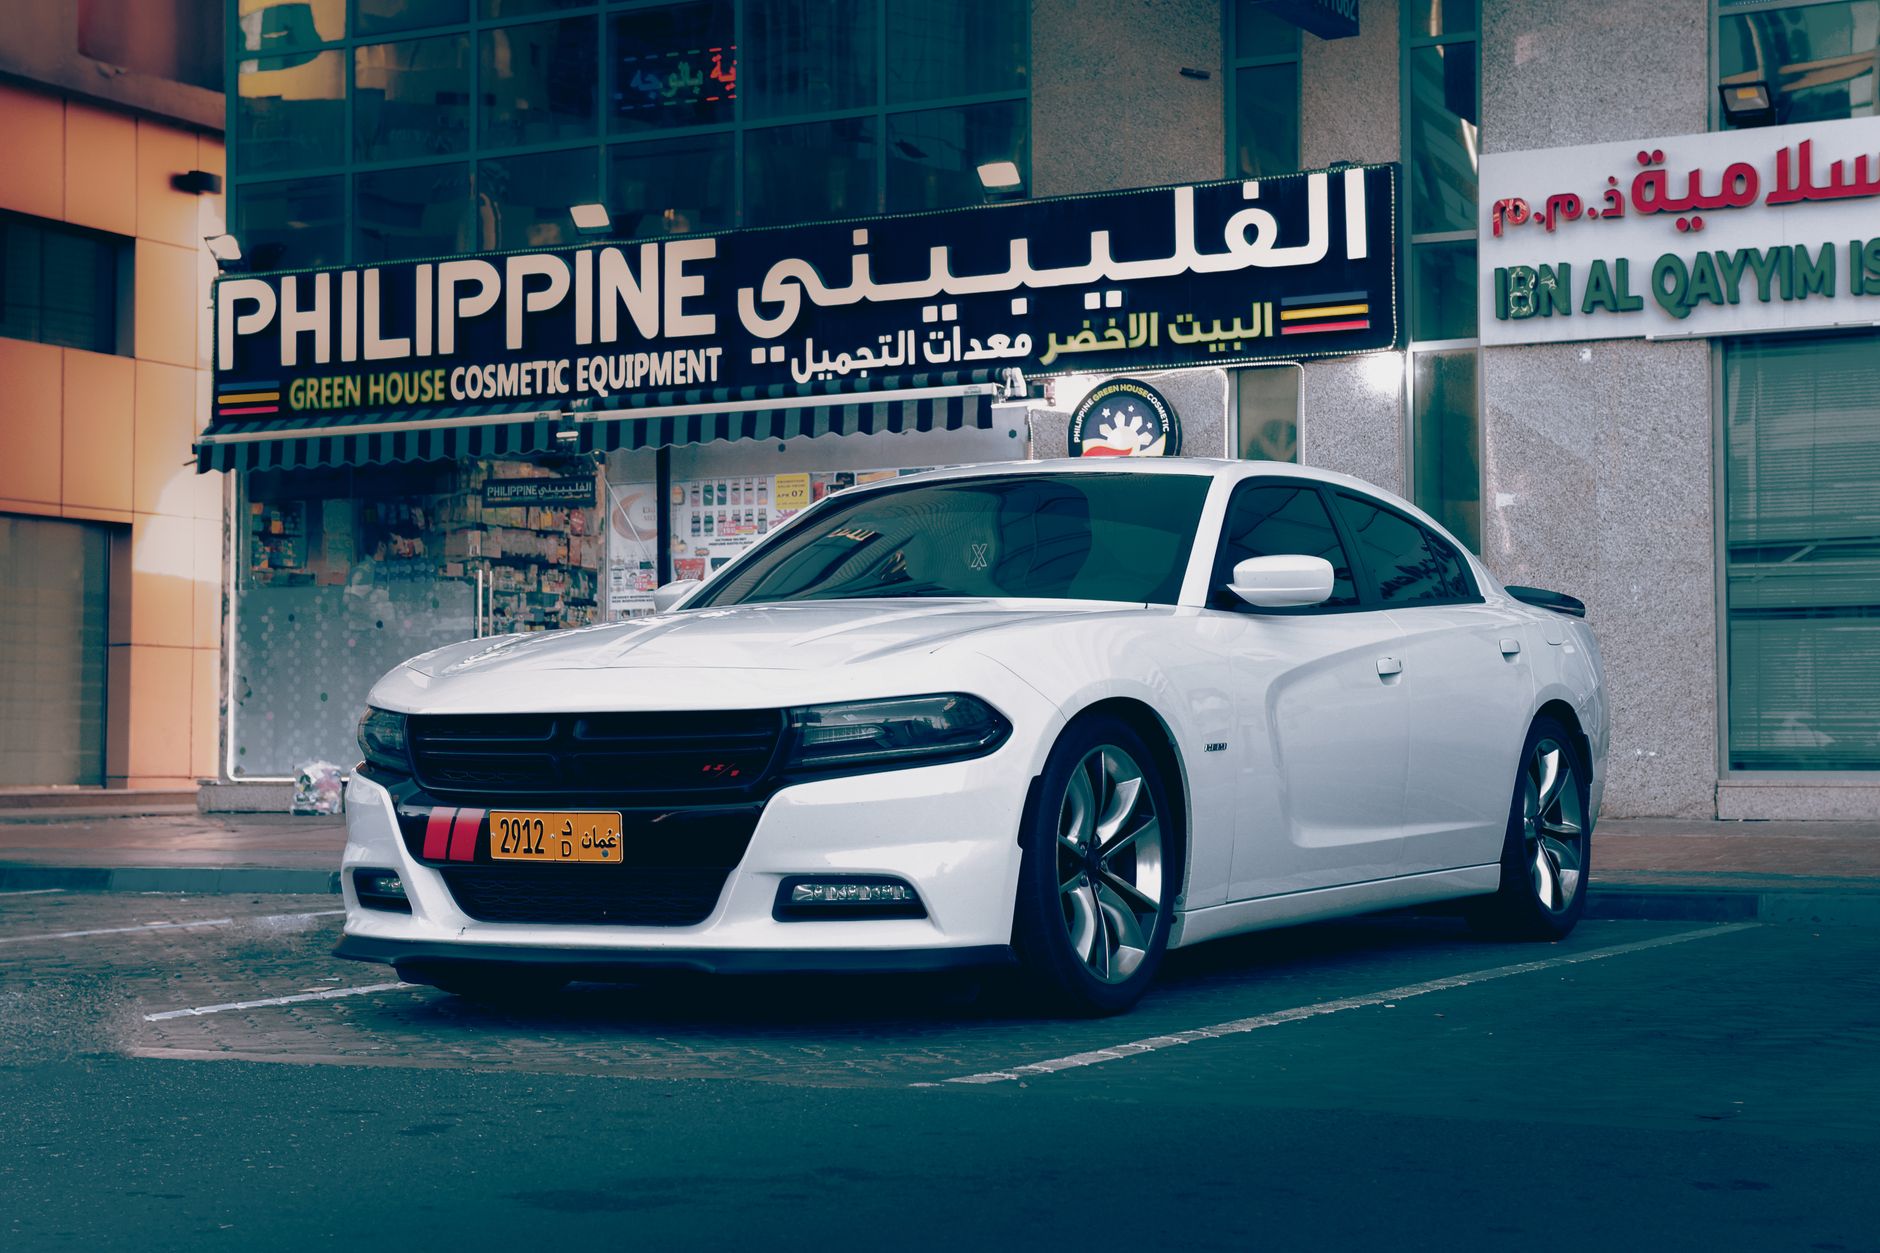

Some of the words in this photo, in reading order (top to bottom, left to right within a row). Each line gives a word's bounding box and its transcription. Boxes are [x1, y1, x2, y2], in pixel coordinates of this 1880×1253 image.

[737, 165, 1367, 364] الفليبيني
[1493, 262, 1573, 321] IBN
[1580, 257, 1645, 315] AL
[1651, 241, 1837, 320] QAYYIM
[219, 238, 717, 371] PHILIPPINE
[1167, 302, 1274, 349] البيت
[790, 329, 917, 385] التجميل
[922, 324, 1033, 363] معدات
[1039, 312, 1159, 365] الاخضر
[289, 376, 361, 410] GREEN
[369, 369, 446, 405] HOUSE
[450, 358, 570, 401] COSMETIC
[576, 347, 723, 398] EQUIPMENT
[1073, 398, 1095, 443] PHILIPPINE
[1092, 384, 1119, 402] GREEN
[1120, 384, 1149, 397] HOUSE
[1146, 393, 1170, 432] COSMETIC
[487, 485, 537, 497] PHILIPPINE
[792, 489, 804, 498] 07
[499, 818, 546, 855] 2912
[561, 840, 573, 858] D
